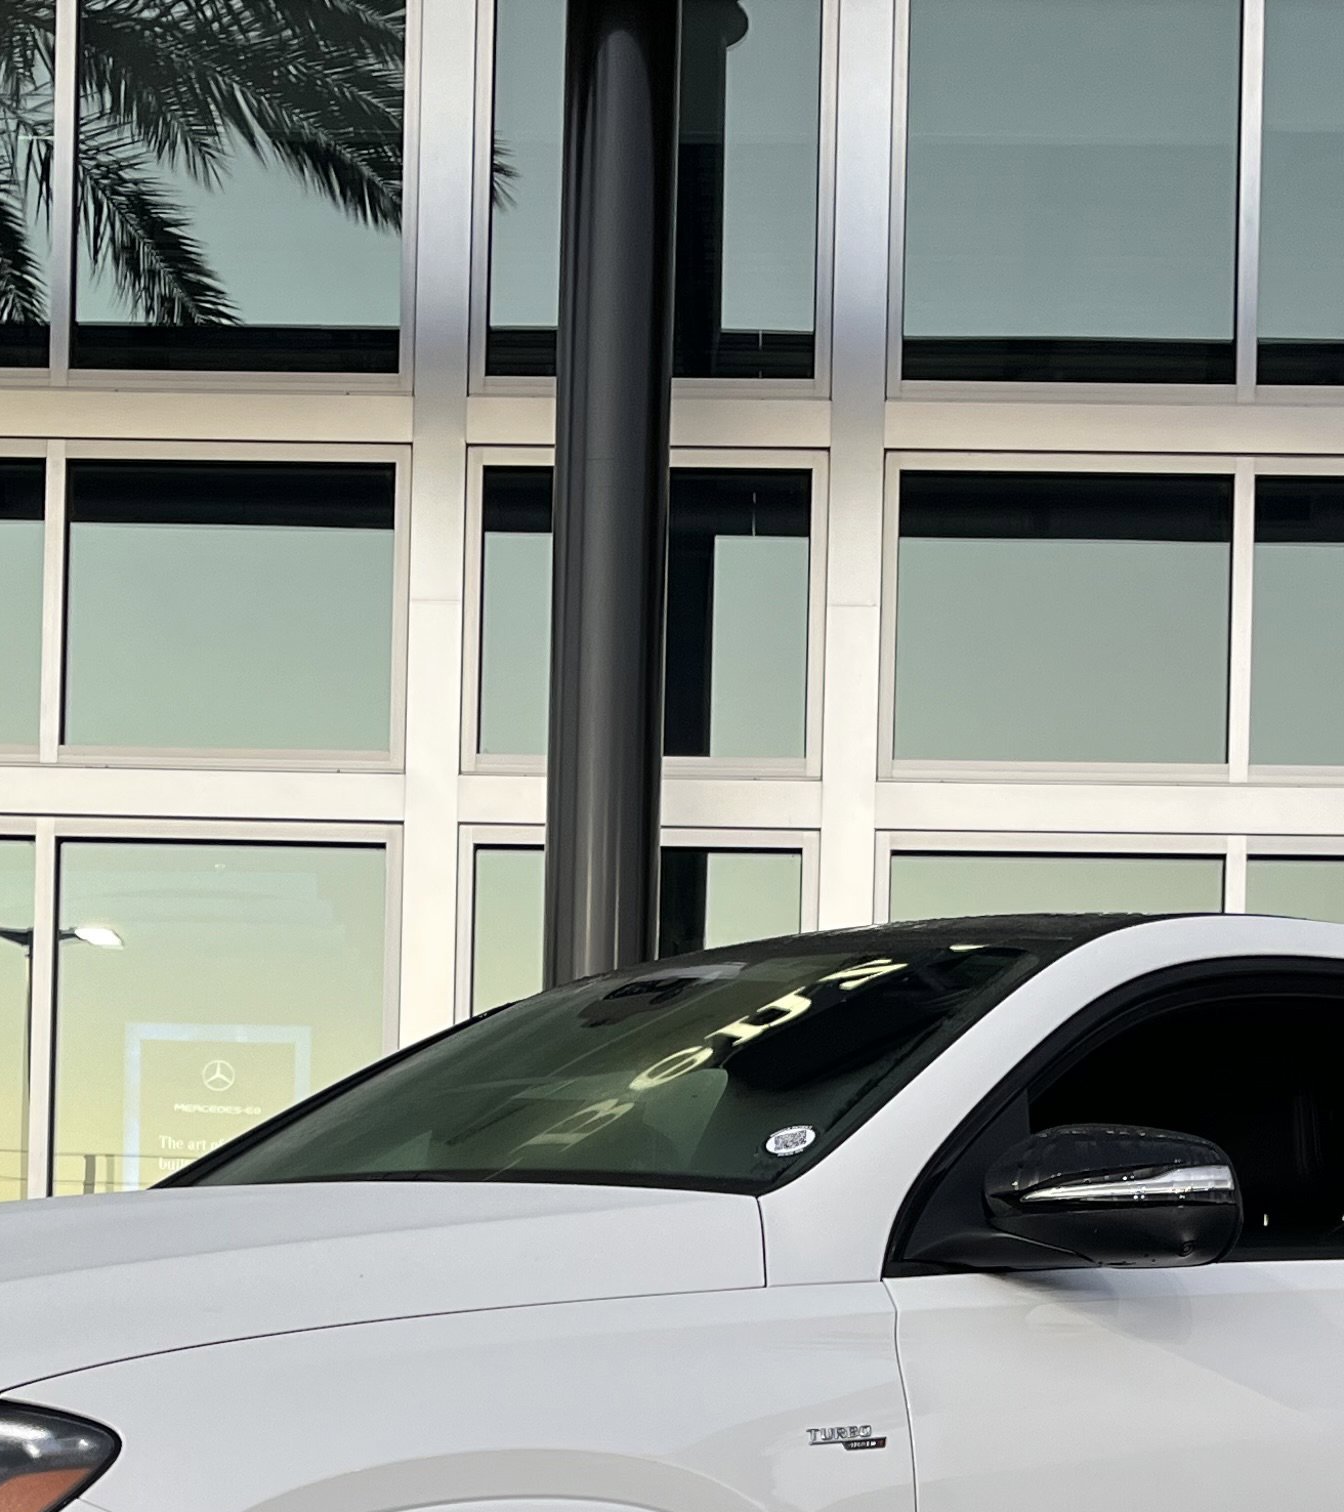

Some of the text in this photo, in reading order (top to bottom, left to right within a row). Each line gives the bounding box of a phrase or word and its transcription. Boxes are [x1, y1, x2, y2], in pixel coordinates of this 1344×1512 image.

[159, 1135, 184, 1149] The
[187, 1140, 206, 1150] art
[806, 1425, 872, 1441] TURBO
